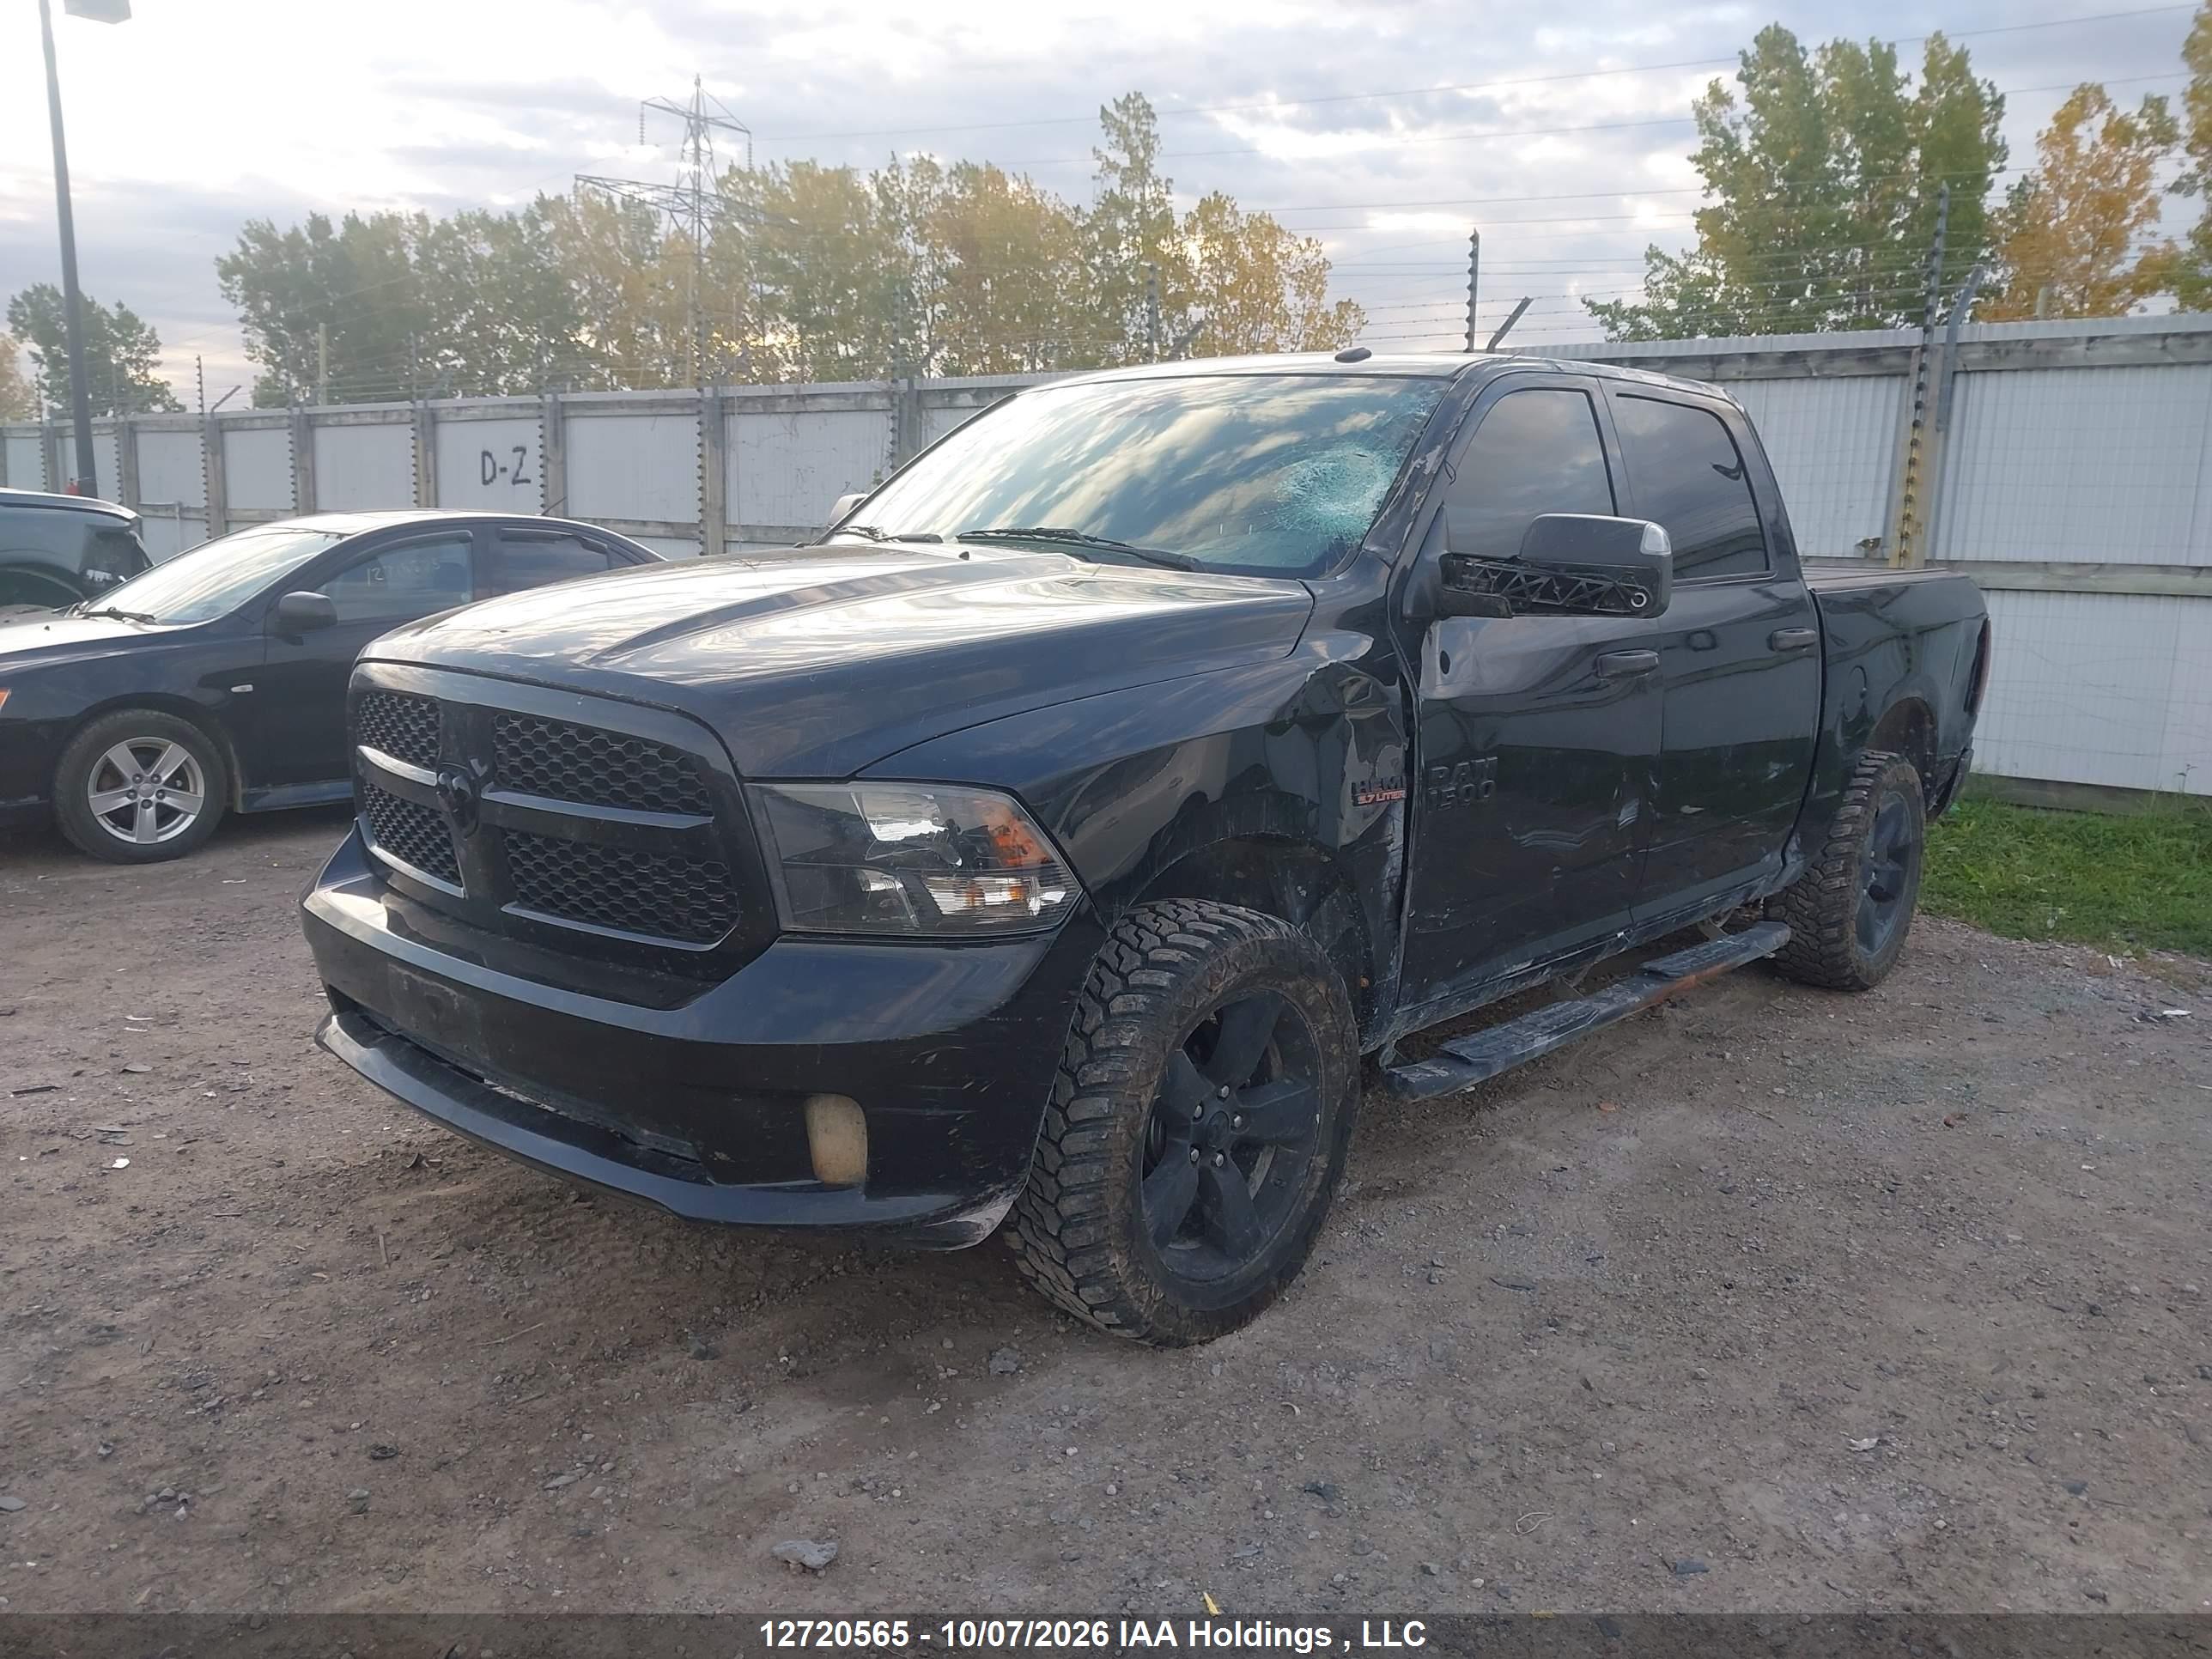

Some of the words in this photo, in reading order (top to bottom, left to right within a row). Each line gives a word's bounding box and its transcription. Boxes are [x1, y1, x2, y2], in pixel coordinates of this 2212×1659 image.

[481, 447, 531, 485] D-Z
[1352, 776, 1407, 794] HEMI
[1428, 756, 1498, 785] RAM
[1358, 794, 1375, 805] 5.7
[1376, 790, 1407, 802] LITER
[1428, 780, 1497, 813] 1500
